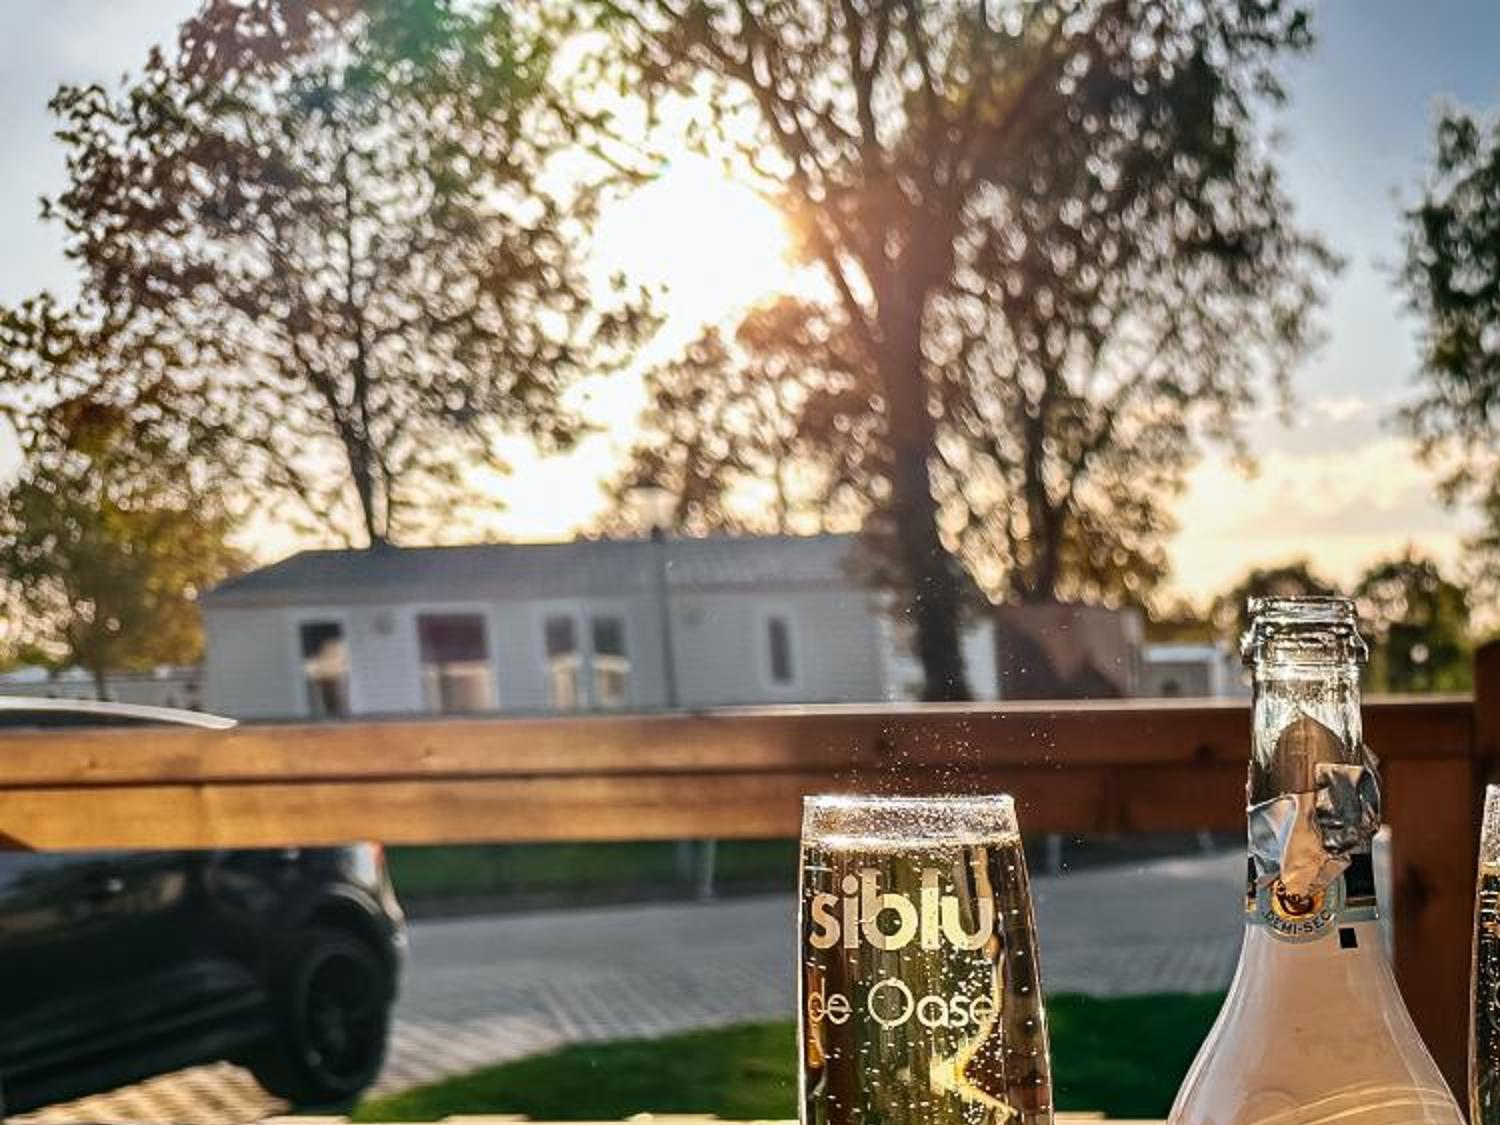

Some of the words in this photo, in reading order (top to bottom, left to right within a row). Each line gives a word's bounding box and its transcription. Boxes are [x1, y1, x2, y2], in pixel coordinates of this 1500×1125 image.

[809, 866, 994, 951] siblu
[807, 975, 850, 1025] de
[867, 976, 995, 1028] Oase
